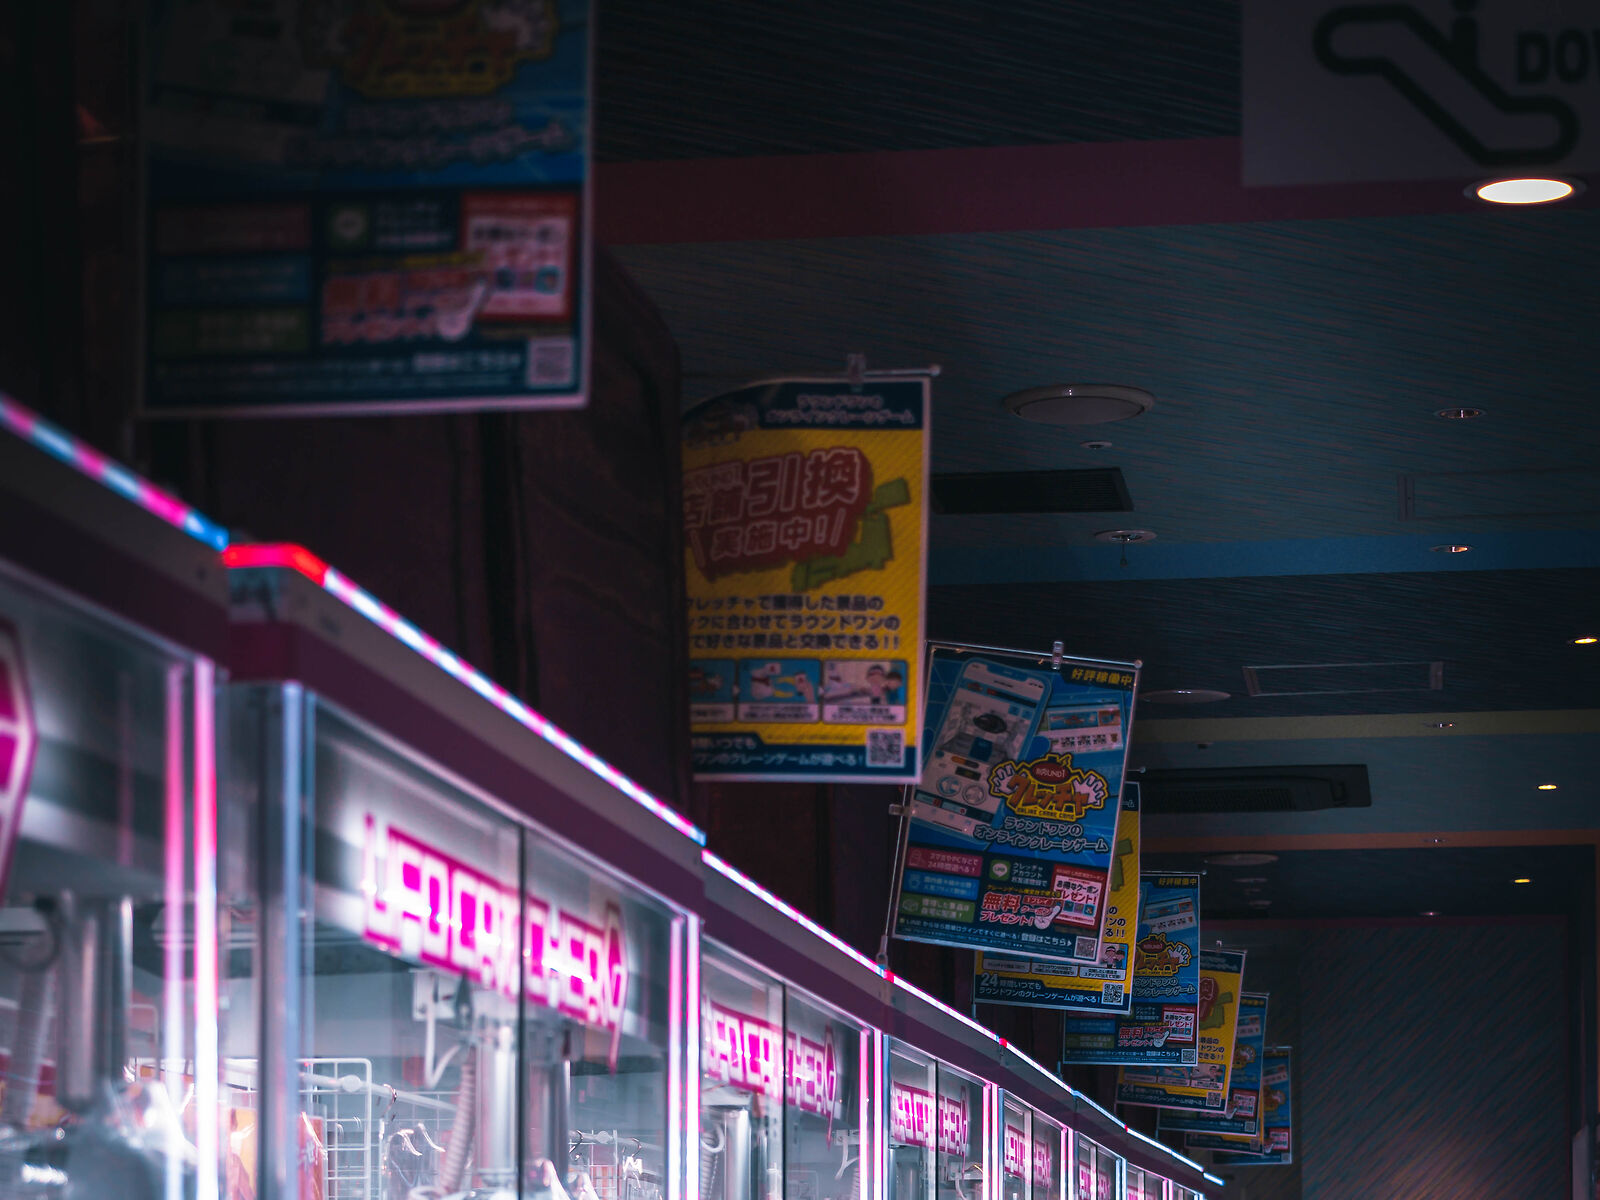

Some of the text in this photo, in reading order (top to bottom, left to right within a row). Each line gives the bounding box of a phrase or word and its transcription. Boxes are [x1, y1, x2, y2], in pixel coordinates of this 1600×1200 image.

[1516, 29, 1600, 85] DO
[1071, 666, 1133, 688] 好評稼働中
[1003, 816, 1083, 837] ラウンドワンの
[973, 825, 1109, 852] オンラインクレーンゲーム
[981, 891, 1021, 913] 無料
[980, 911, 1035, 927] プレゼント!
